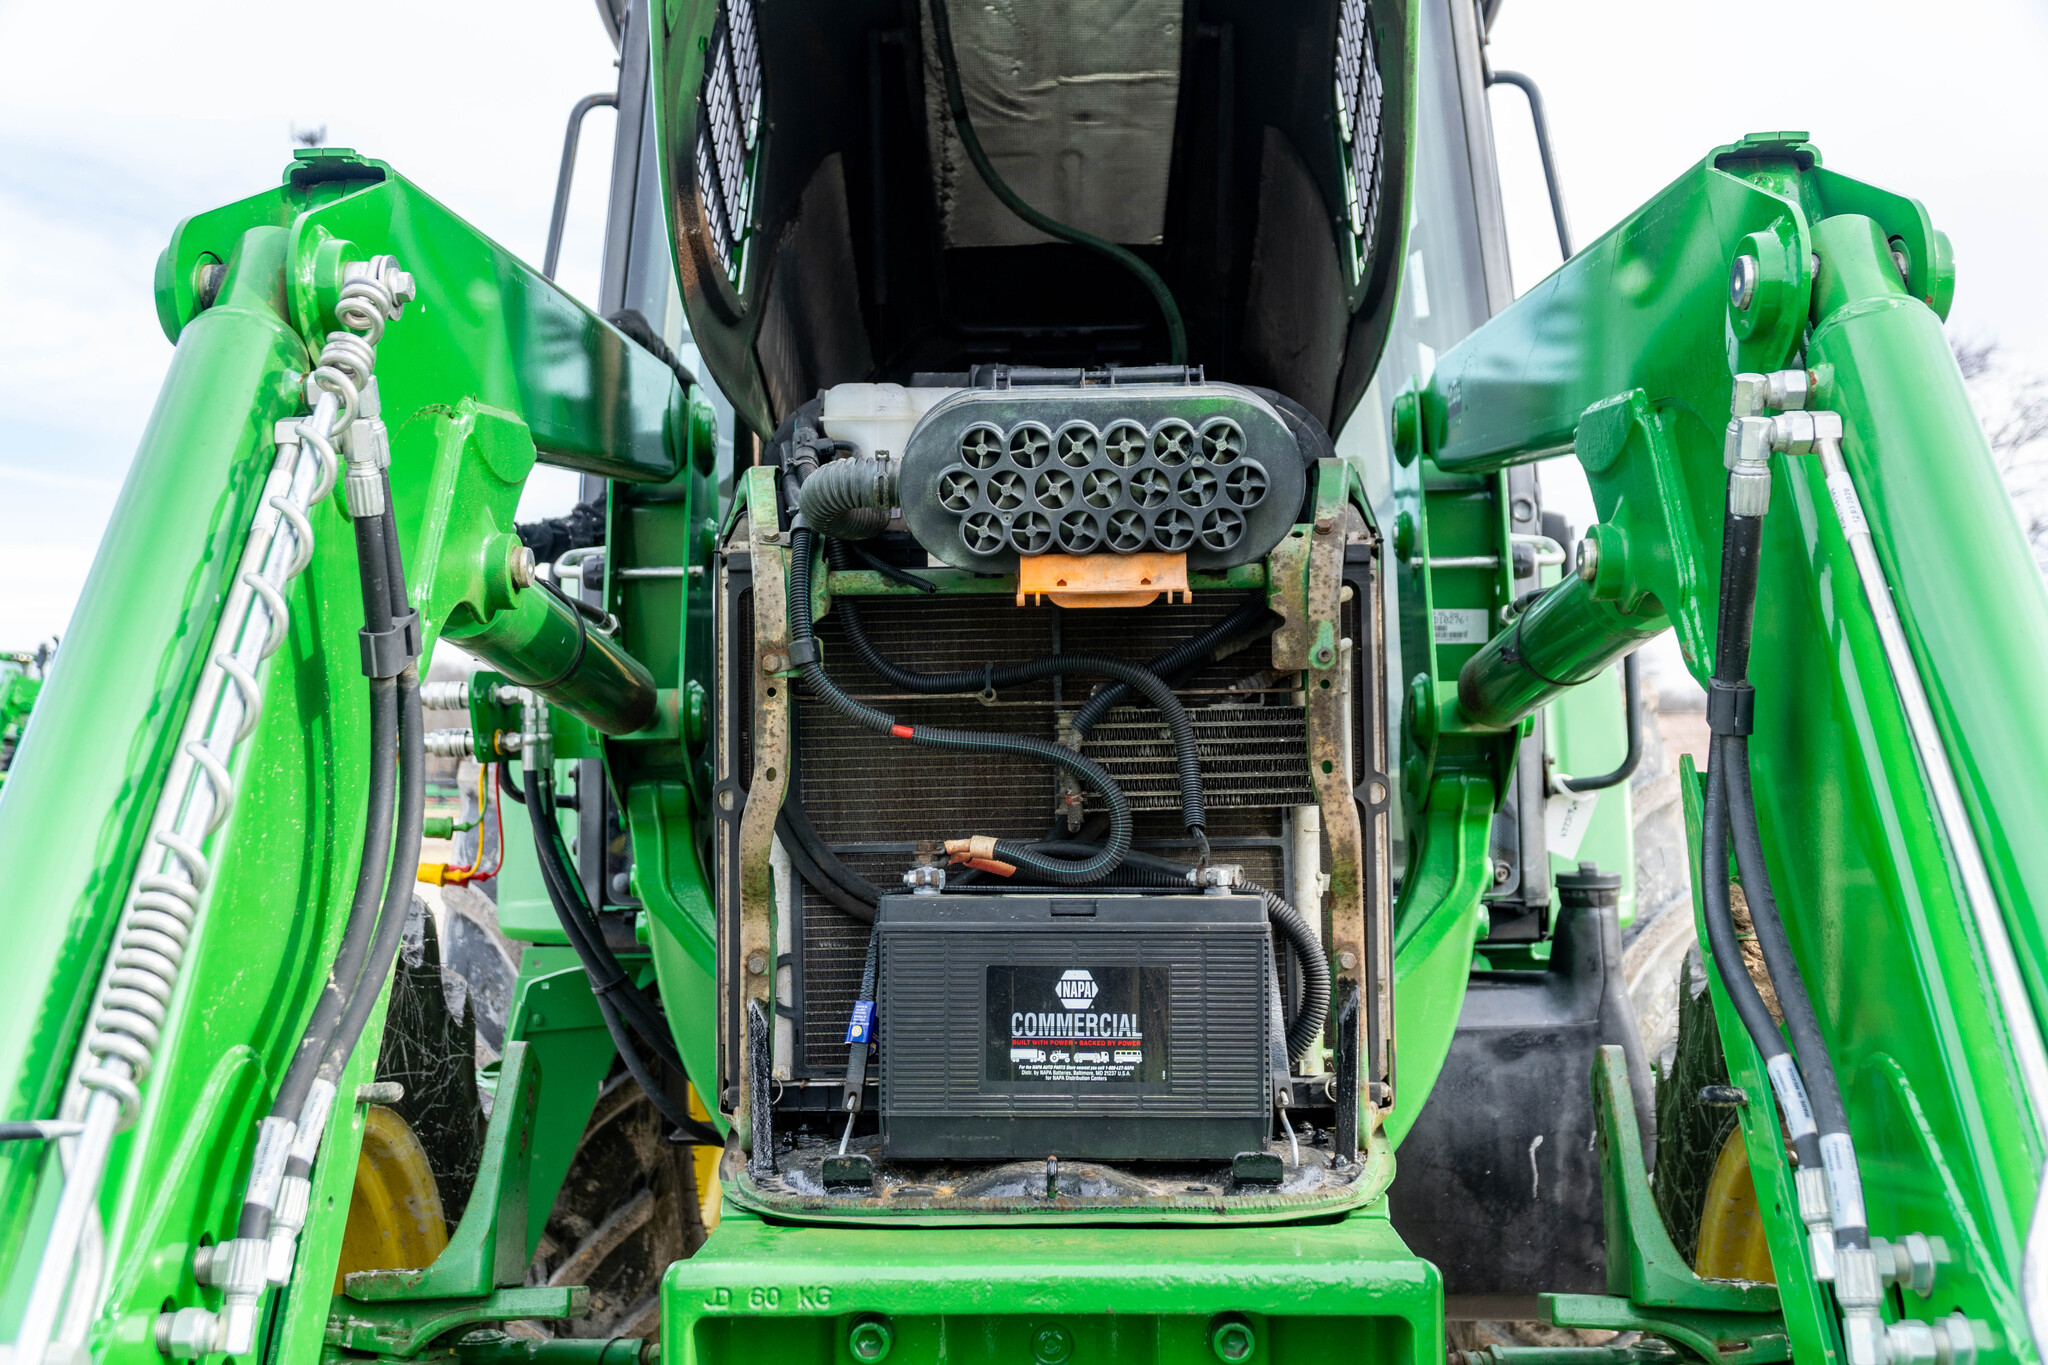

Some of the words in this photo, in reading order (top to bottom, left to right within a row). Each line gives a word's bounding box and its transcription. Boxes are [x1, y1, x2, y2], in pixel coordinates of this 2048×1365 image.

[1062, 981, 1092, 998] NAPA
[1011, 1012, 1142, 1037] COMMERCIAL
[704, 1286, 733, 1311] JD
[747, 1286, 782, 1311] 60
[797, 1285, 833, 1311] KG
